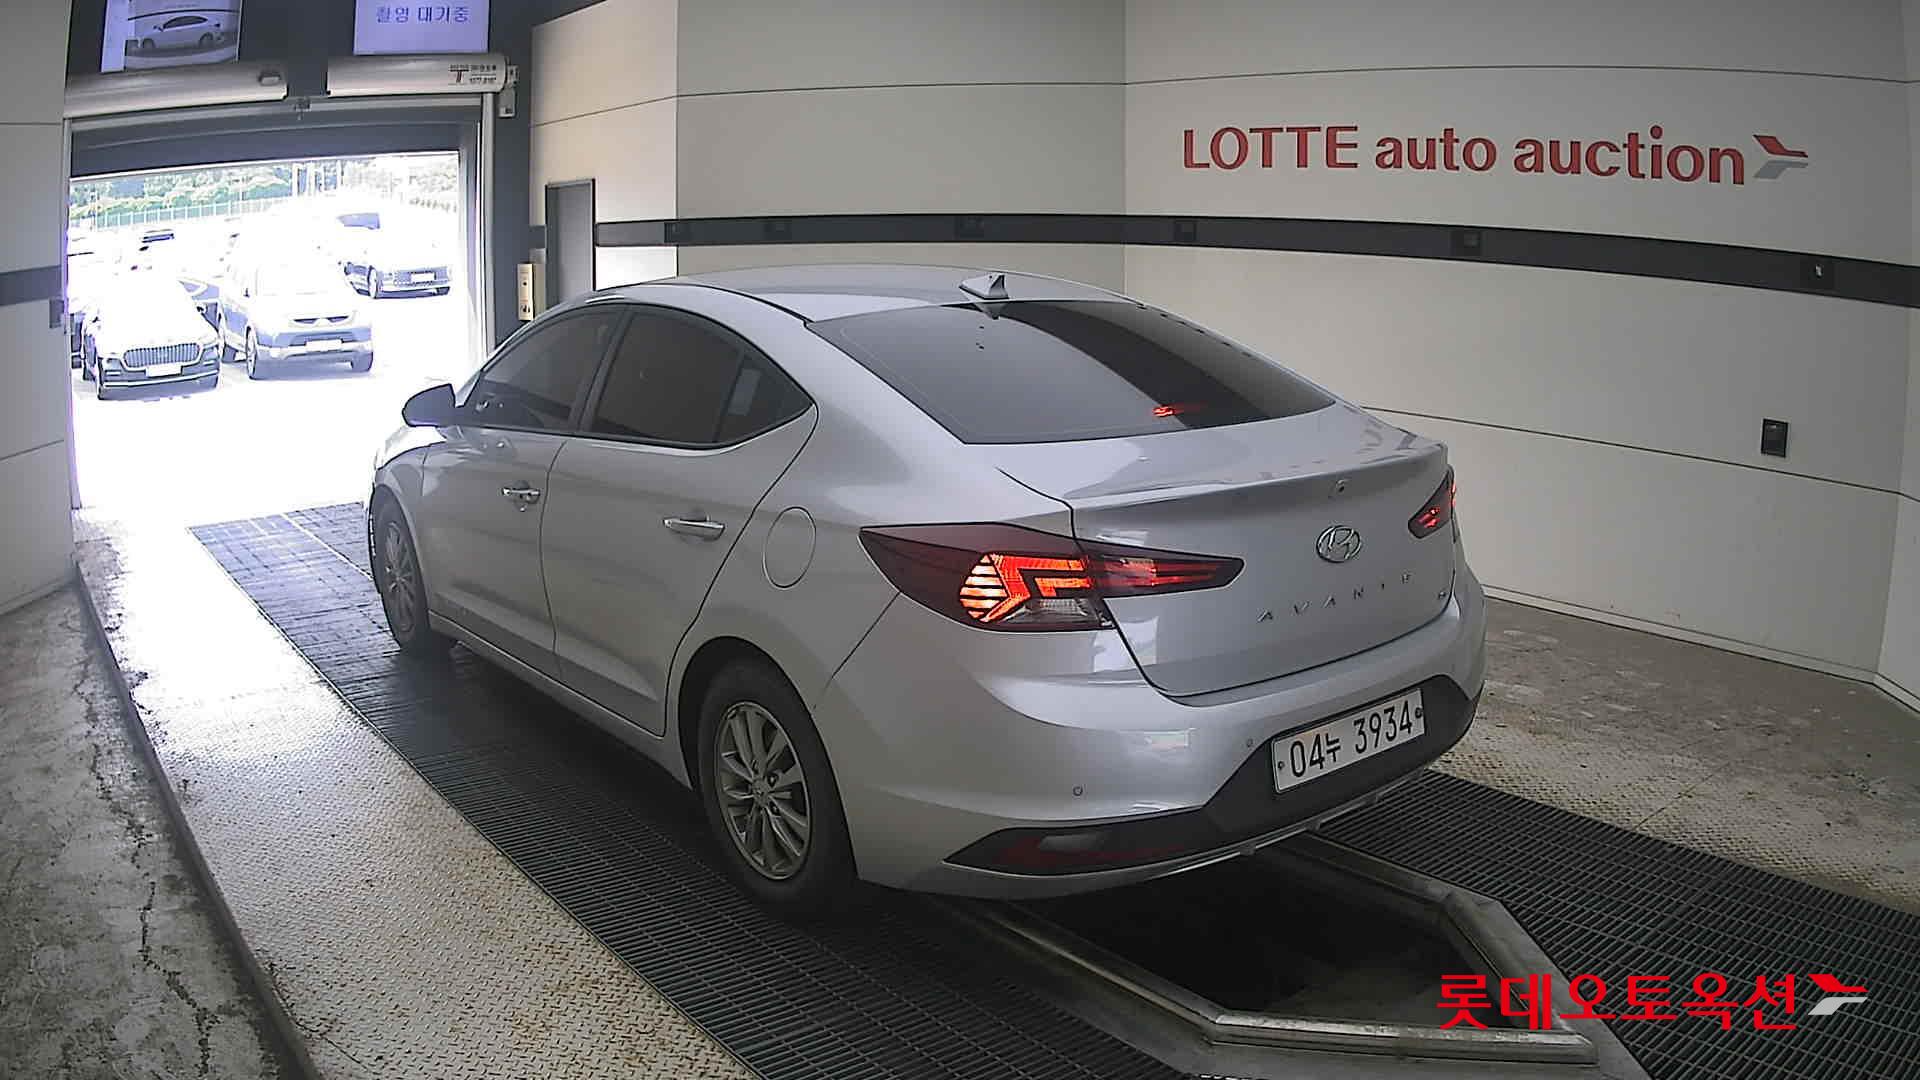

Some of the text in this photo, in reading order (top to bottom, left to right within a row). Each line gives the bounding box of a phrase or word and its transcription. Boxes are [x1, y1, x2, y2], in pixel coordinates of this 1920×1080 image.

[418, 6, 469, 23] 대기중
[1183, 125, 1745, 184] LOTTE auto auction
[1289, 699, 1413, 778] 04누 3934
